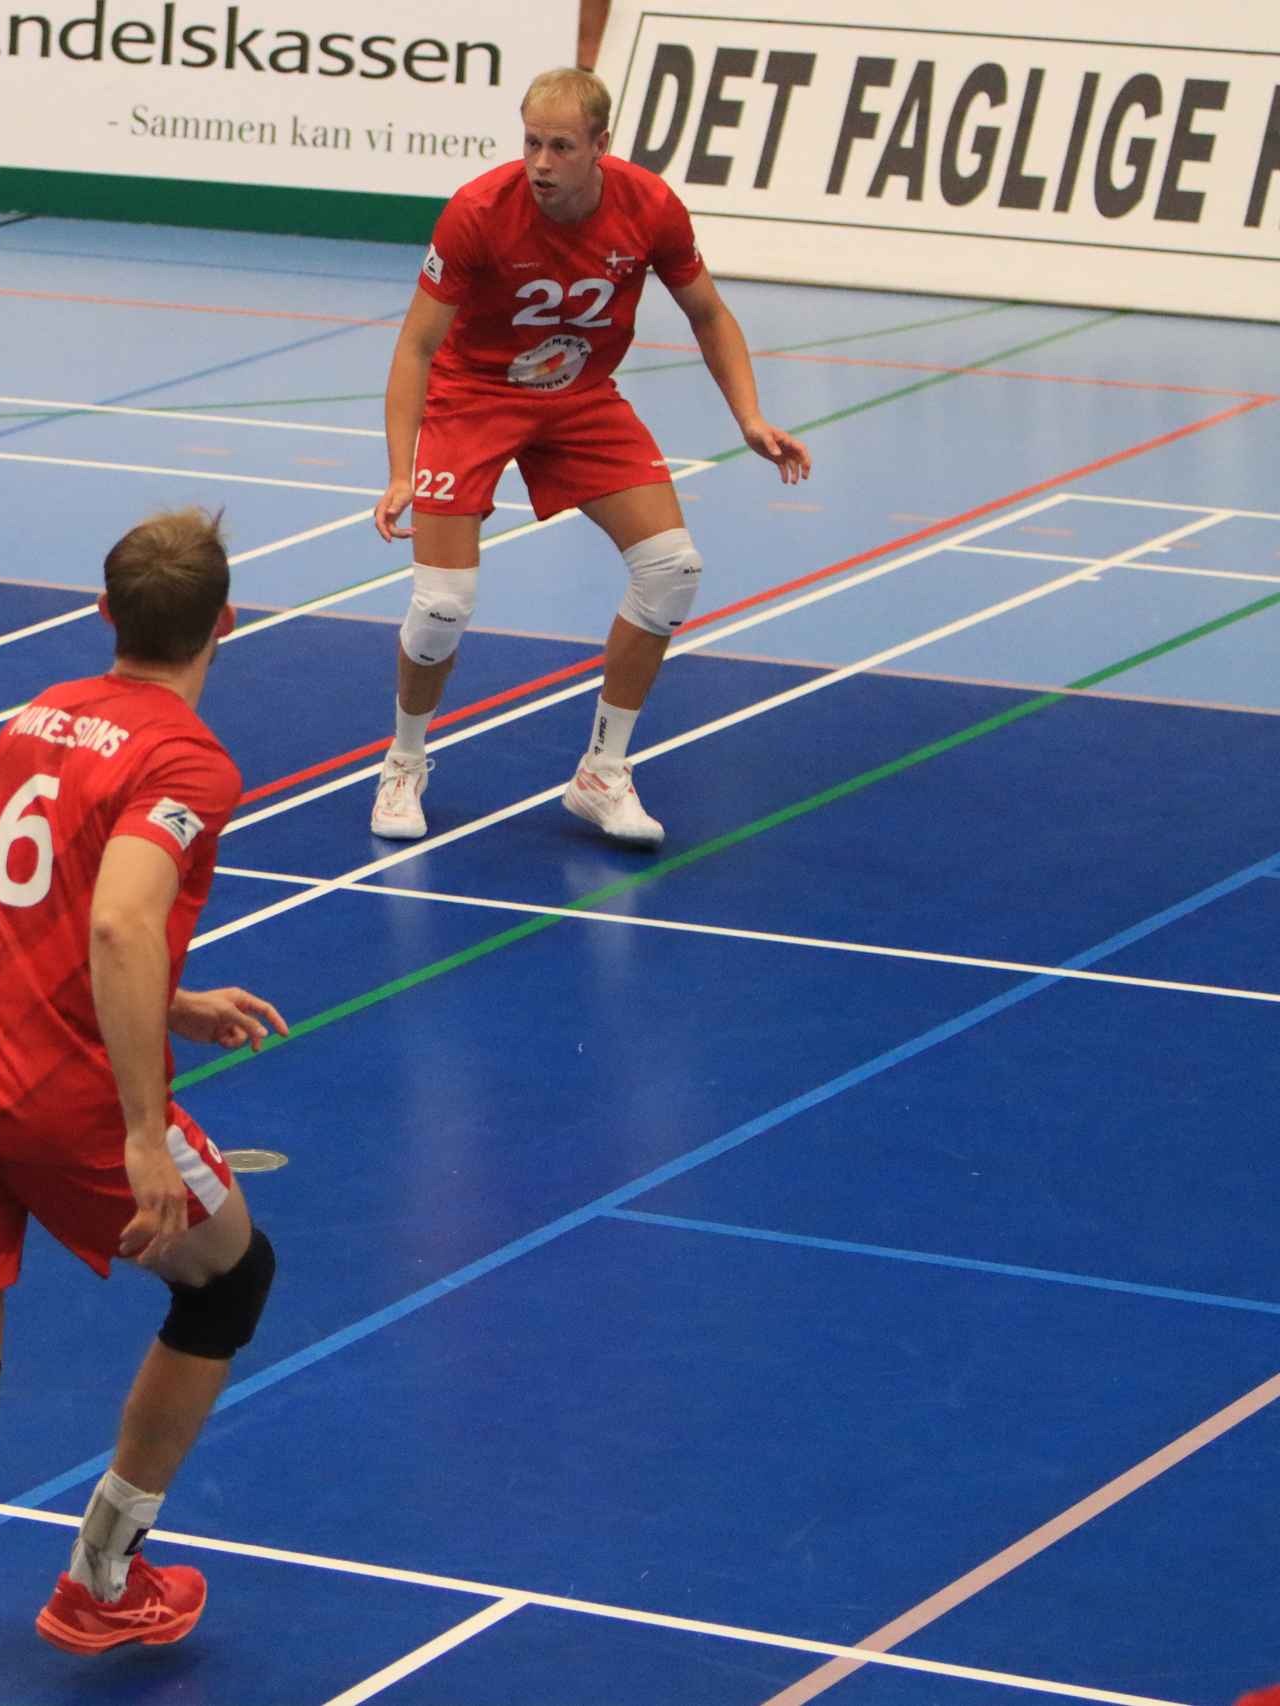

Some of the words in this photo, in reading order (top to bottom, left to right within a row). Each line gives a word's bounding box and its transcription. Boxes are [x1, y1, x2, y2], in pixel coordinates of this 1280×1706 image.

[130, 104, 278, 146] Sammen
[290, 114, 353, 151] kan
[365, 121, 393, 153] vi
[406, 131, 497, 160] mere
[630, 42, 817, 190] DET
[825, 55, 1231, 224] FAGLIGE
[512, 278, 615, 328] 22
[415, 468, 456, 501] 22
